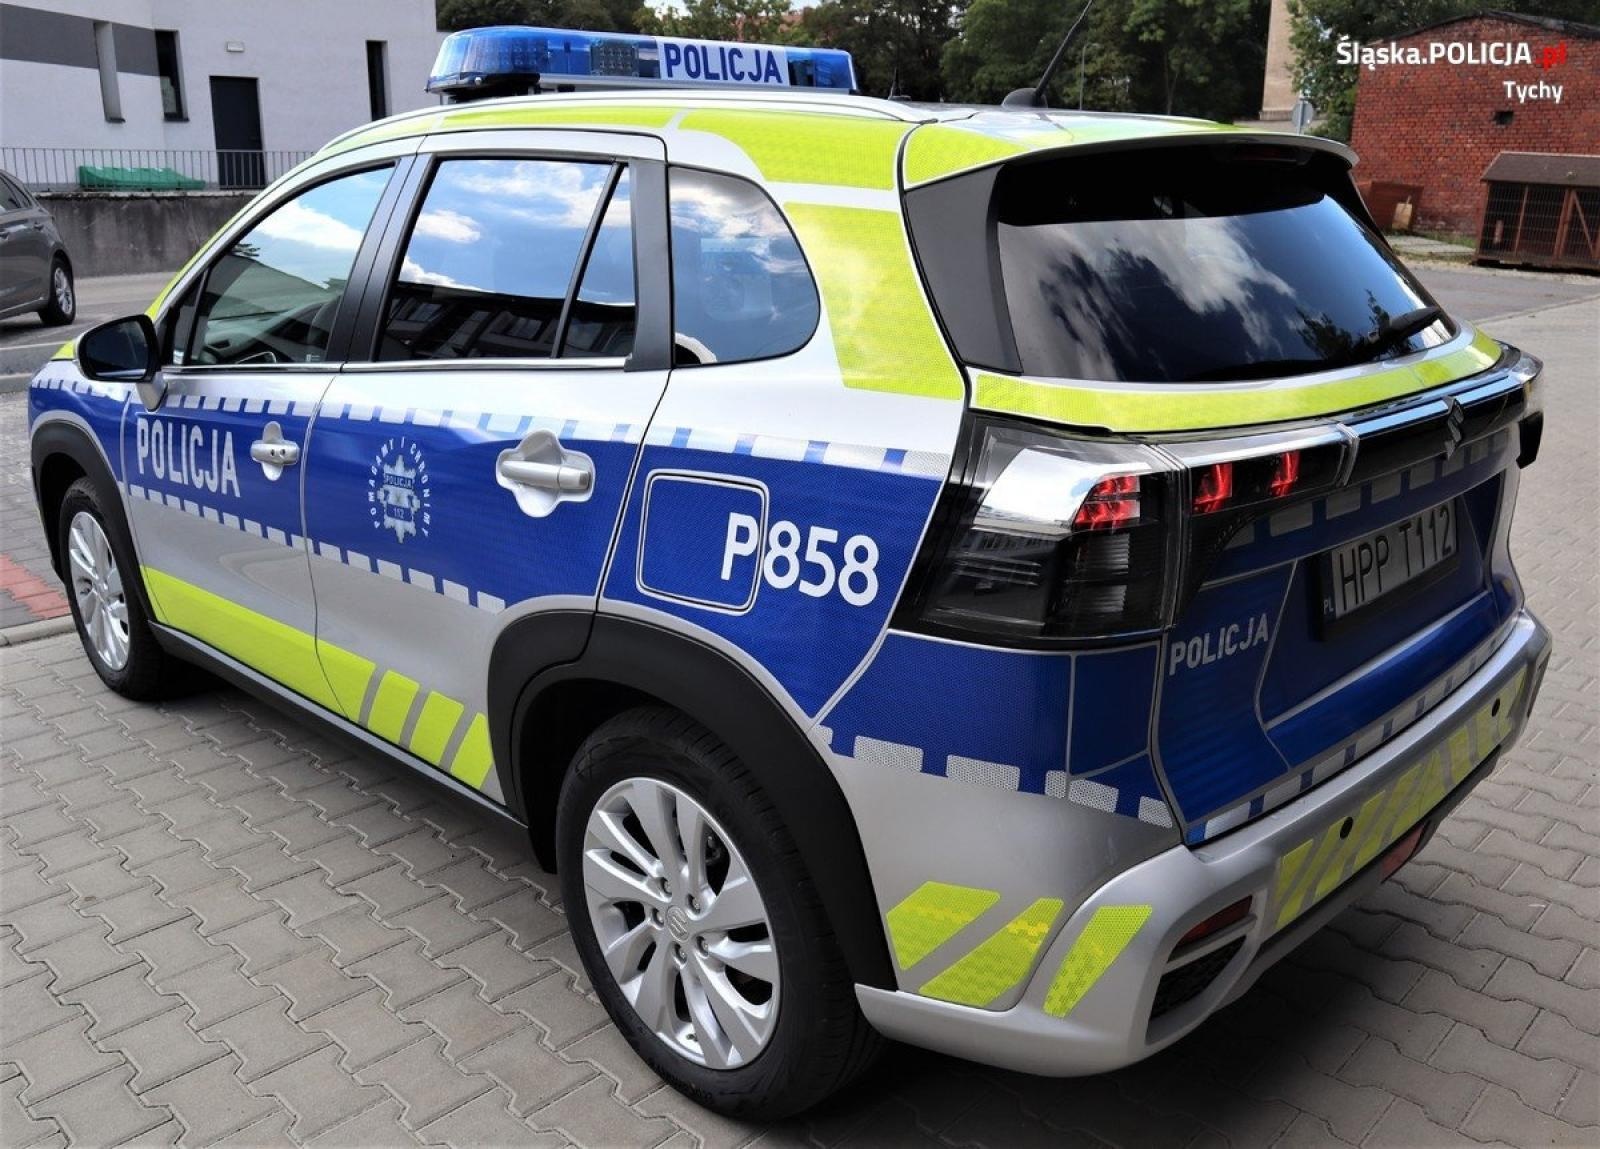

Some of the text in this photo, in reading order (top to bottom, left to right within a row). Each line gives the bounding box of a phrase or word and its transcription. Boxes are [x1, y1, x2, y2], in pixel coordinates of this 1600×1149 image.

[664, 43, 782, 84] POLICJA
[137, 417, 241, 498] POLICJA
[384, 474, 412, 489] POLICJA
[720, 512, 879, 606] P858
[1323, 505, 1452, 615] PL HPP T112
[1168, 613, 1269, 676] POLICJA
